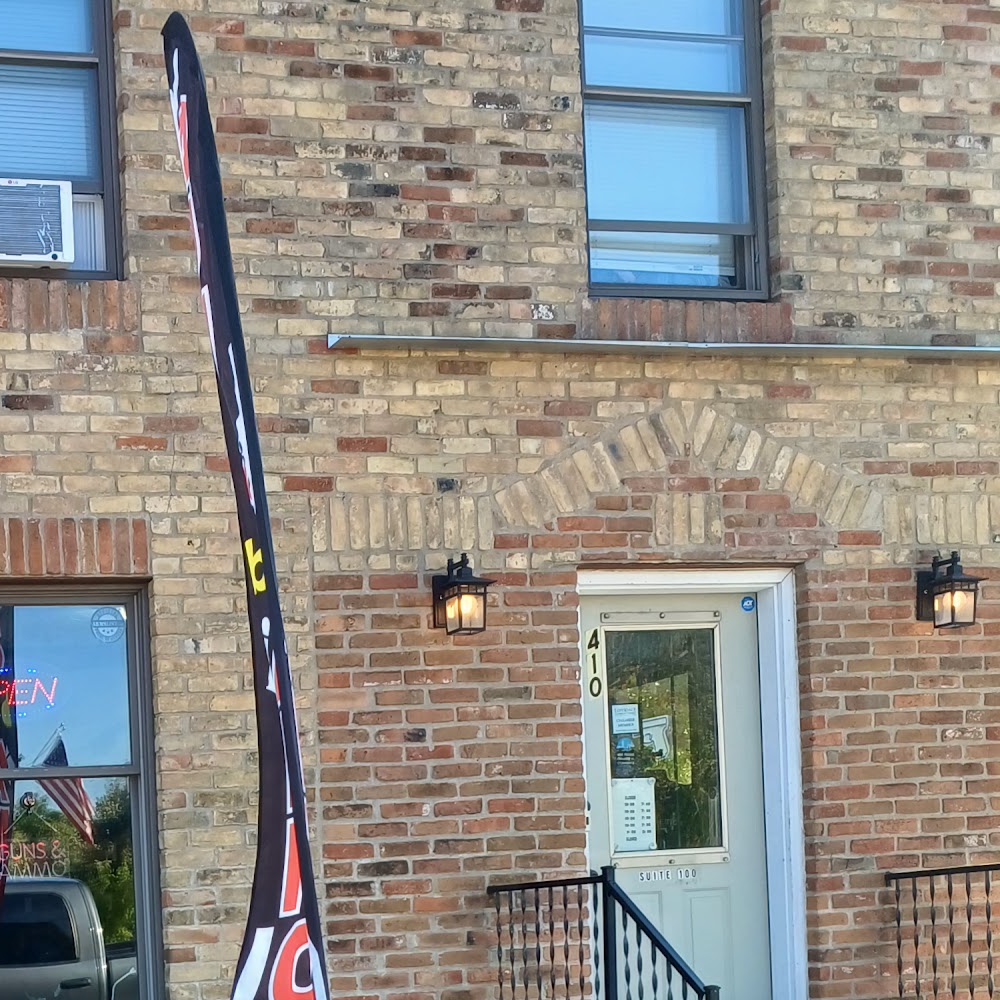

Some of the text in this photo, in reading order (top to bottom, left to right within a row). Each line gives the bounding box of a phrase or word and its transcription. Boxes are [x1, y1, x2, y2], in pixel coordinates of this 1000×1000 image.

[587, 628, 602, 698] 410
[52, 840, 66, 858] &
[0, 861, 68, 879] AMMO
[639, 868, 697, 881] SUITE 100
